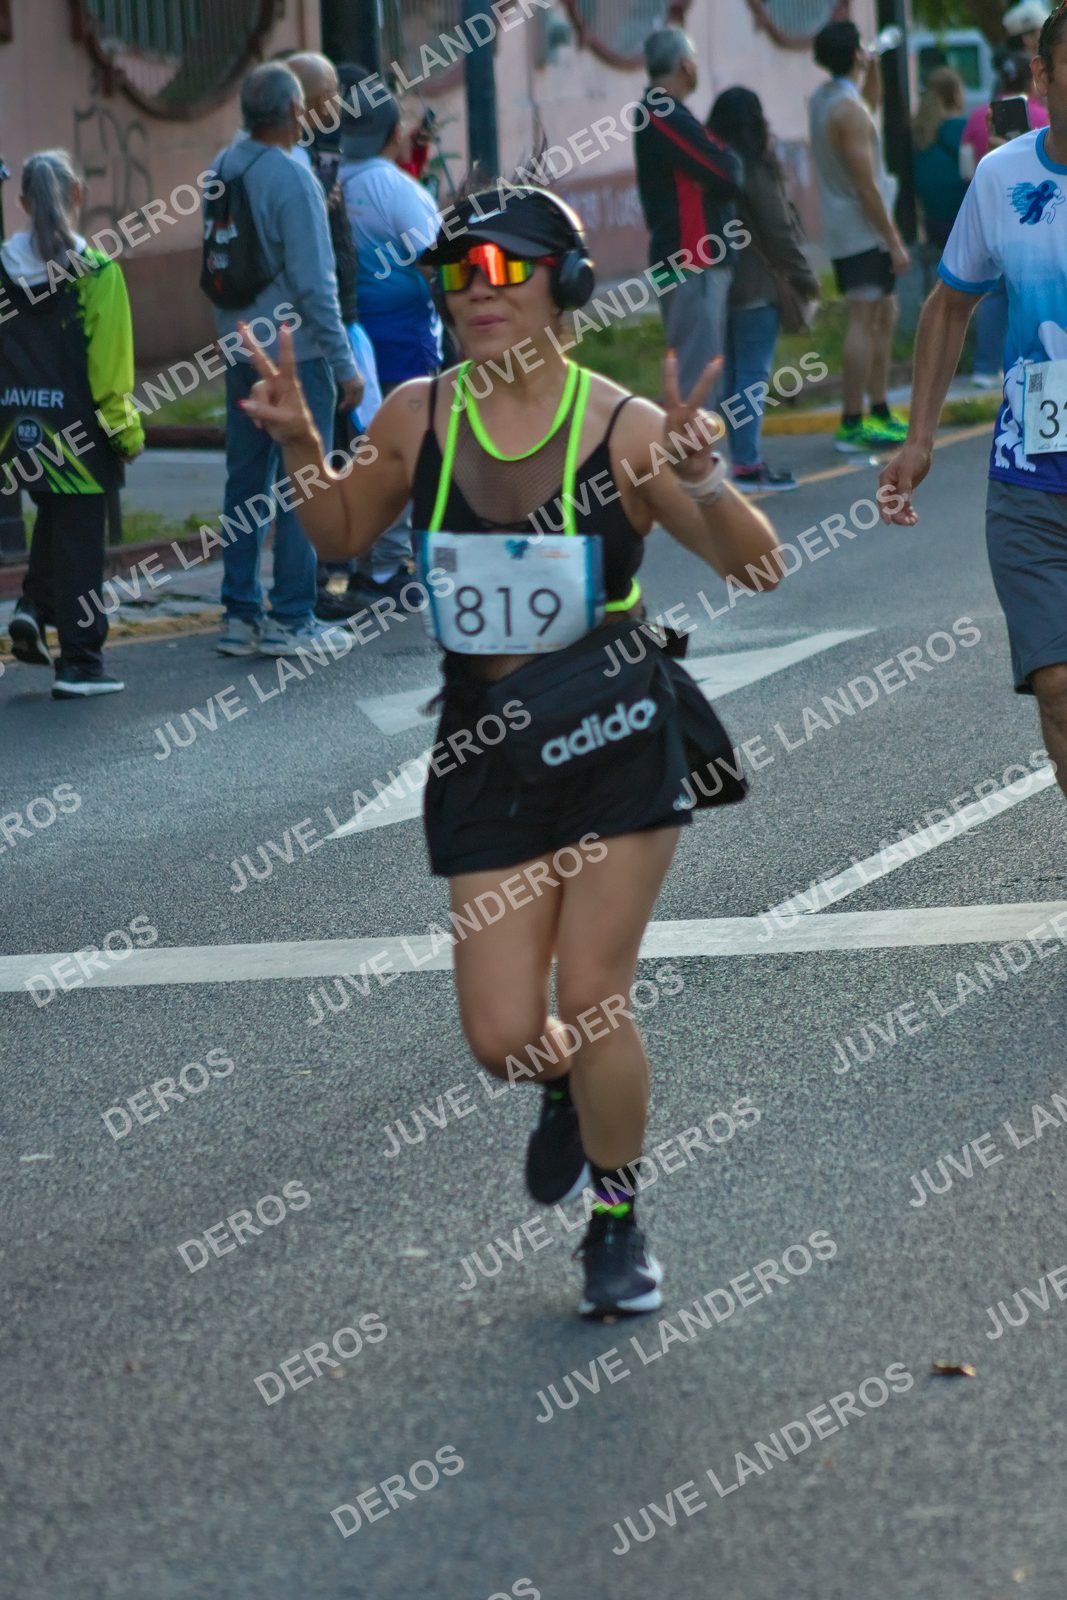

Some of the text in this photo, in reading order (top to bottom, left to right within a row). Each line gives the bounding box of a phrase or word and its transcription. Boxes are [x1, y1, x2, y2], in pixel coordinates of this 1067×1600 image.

[1, 388, 64, 409] JAVIER
[1039, 399, 1067, 439] 3
[455, 585, 561, 637] 819
